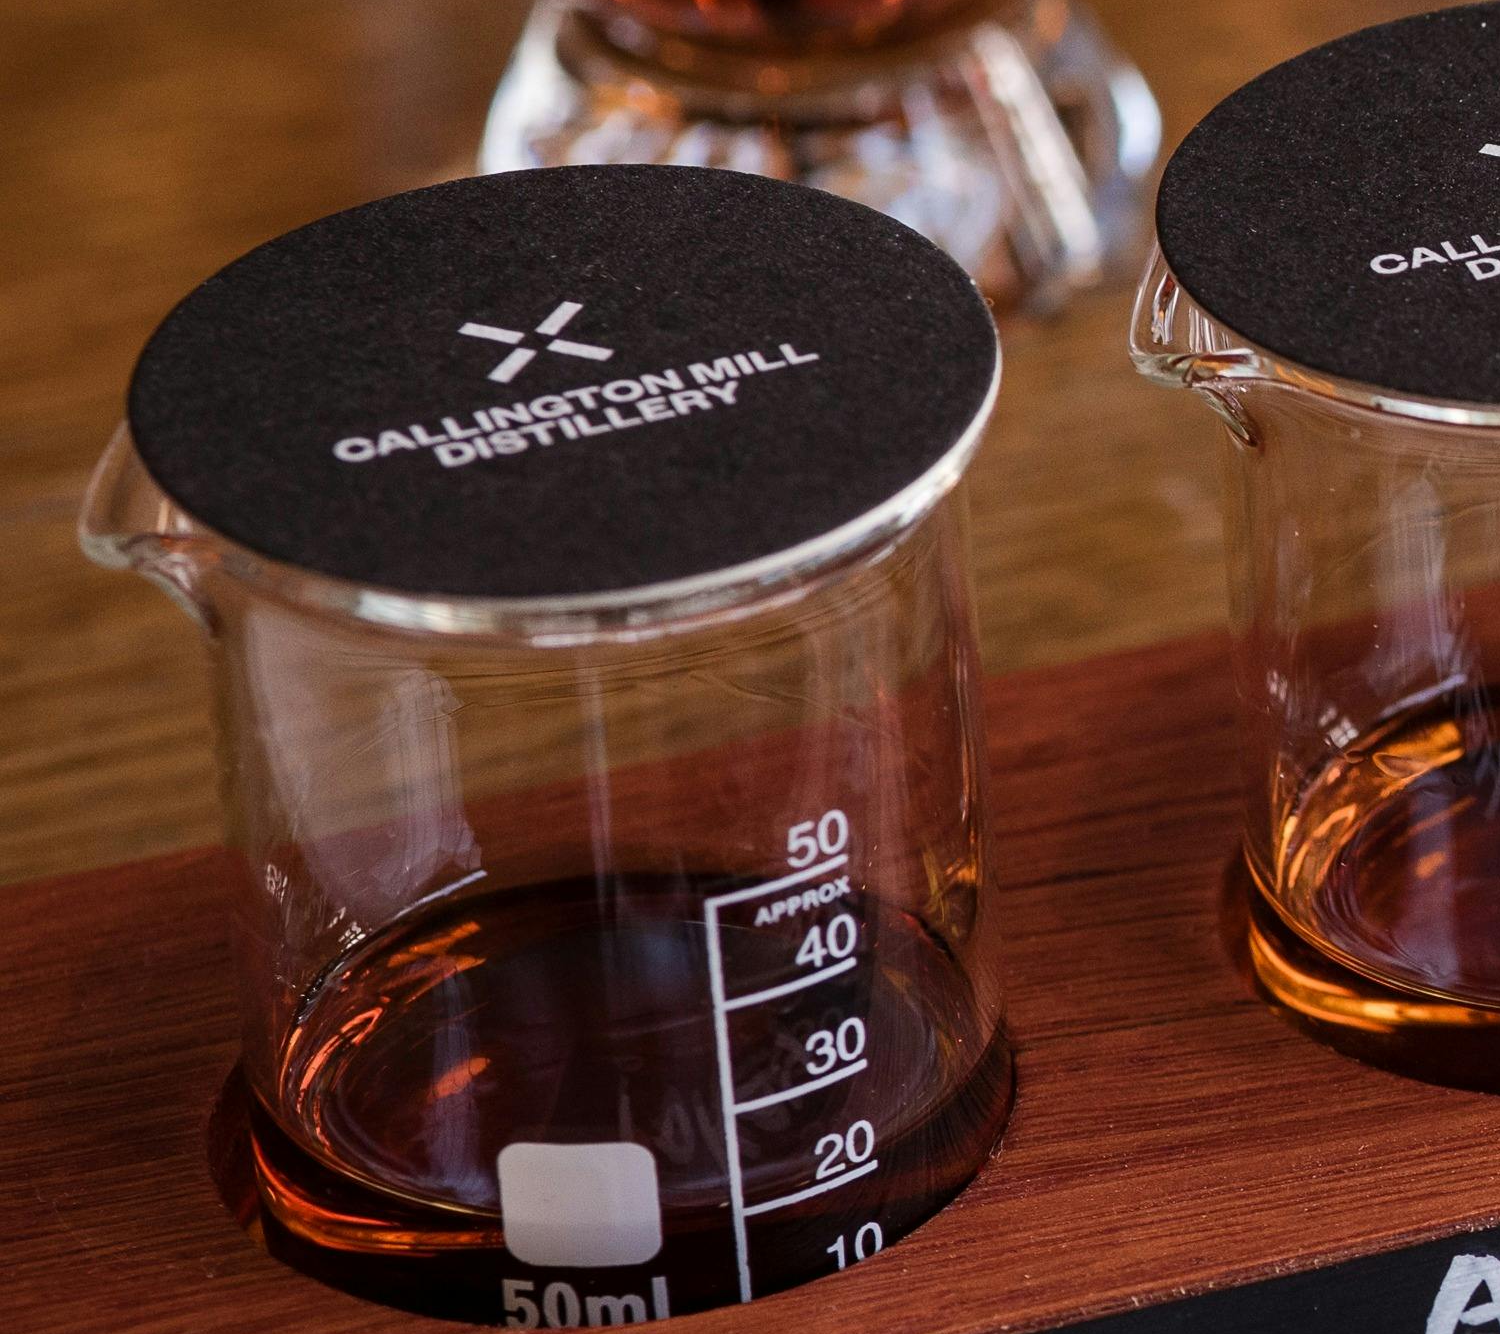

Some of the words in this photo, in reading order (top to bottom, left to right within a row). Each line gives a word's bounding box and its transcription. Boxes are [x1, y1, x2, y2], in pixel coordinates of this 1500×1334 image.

[333, 369, 684, 462] CALLINGTON
[688, 343, 820, 386] MILL
[434, 381, 740, 468] DISTILLERY
[787, 809, 848, 868] 50
[754, 876, 851, 926] APPROX
[795, 914, 857, 968] 40
[805, 1017, 866, 1075] 30
[814, 1120, 875, 1179] 20
[828, 1222, 882, 1269] 10
[502, 1276, 670, 1330] 50ml
